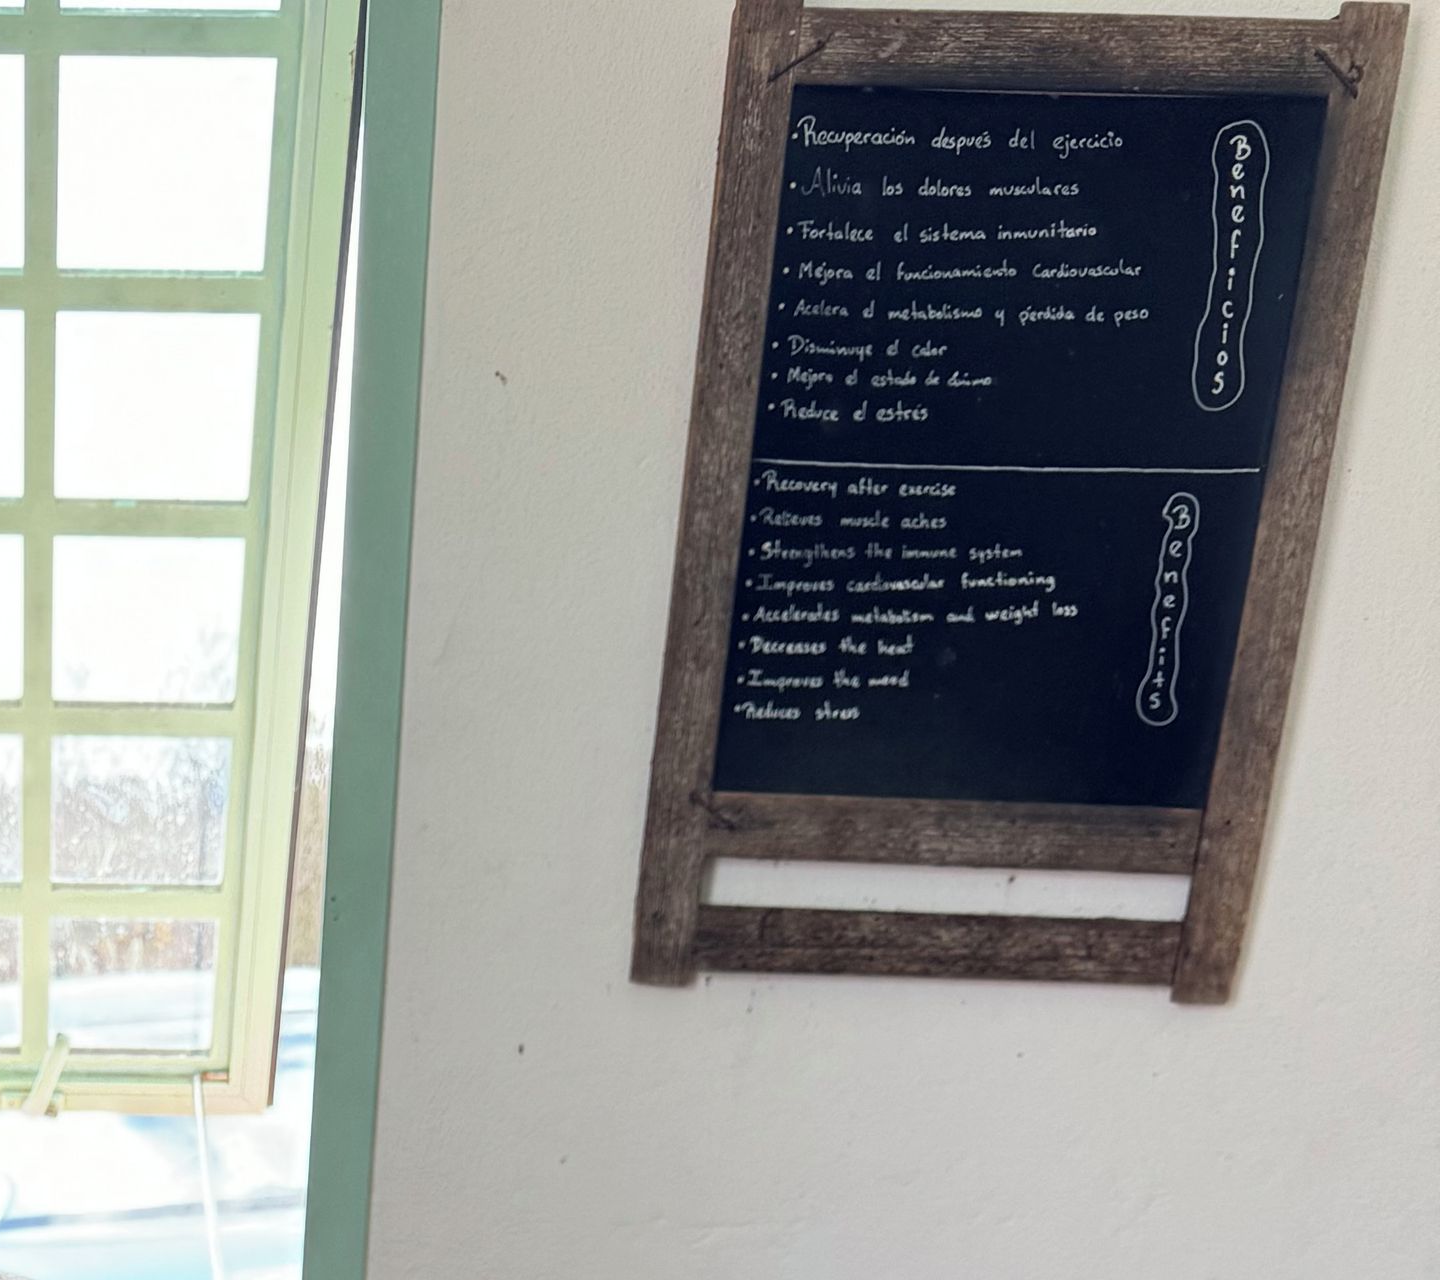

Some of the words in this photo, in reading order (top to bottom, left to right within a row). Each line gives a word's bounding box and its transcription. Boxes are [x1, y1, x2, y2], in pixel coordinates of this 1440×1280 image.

[797, 115, 916, 152] Recuperación
[931, 127, 992, 155] después
[1008, 129, 1035, 150] del
[1052, 131, 1123, 159] ejercicio
[801, 166, 862, 197] Alivia
[882, 175, 904, 196] los
[918, 177, 972, 197] dolores
[989, 177, 1080, 196] musculares
[798, 219, 874, 242] Fortalece
[893, 223, 909, 243] el
[919, 223, 987, 243] sistema
[997, 219, 1097, 241] inmunitario
[865, 262, 881, 281] el
[896, 259, 1017, 281] funcionamiento
[1211, 134, 1252, 395] Beneficios
[793, 299, 849, 318] Acelera
[862, 301, 875, 319] el
[887, 301, 983, 320] metabolismo
[994, 309, 1006, 327] y
[1085, 306, 1105, 322] de
[1114, 309, 1149, 327] peso
[788, 334, 873, 362] Disminuye
[886, 339, 900, 357] el
[911, 340, 948, 358] calor
[845, 369, 859, 387] el
[871, 369, 918, 388] estado
[925, 370, 941, 387] de
[780, 398, 840, 422] Reduce
[852, 400, 868, 422] el
[875, 400, 929, 422] estrés
[762, 469, 839, 498] Recovery
[847, 477, 888, 496] after
[898, 482, 956, 497] exercise
[759, 507, 824, 528] Relieves
[840, 512, 890, 529] muscle
[901, 513, 948, 530] aches
[866, 543, 893, 560] the
[902, 547, 957, 560] immune
[961, 571, 1056, 593] functioning
[985, 600, 1039, 625] weight
[1051, 601, 1079, 618] loss
[1149, 503, 1191, 710] Benefits
[838, 635, 867, 656] the
[833, 668, 861, 689] the
